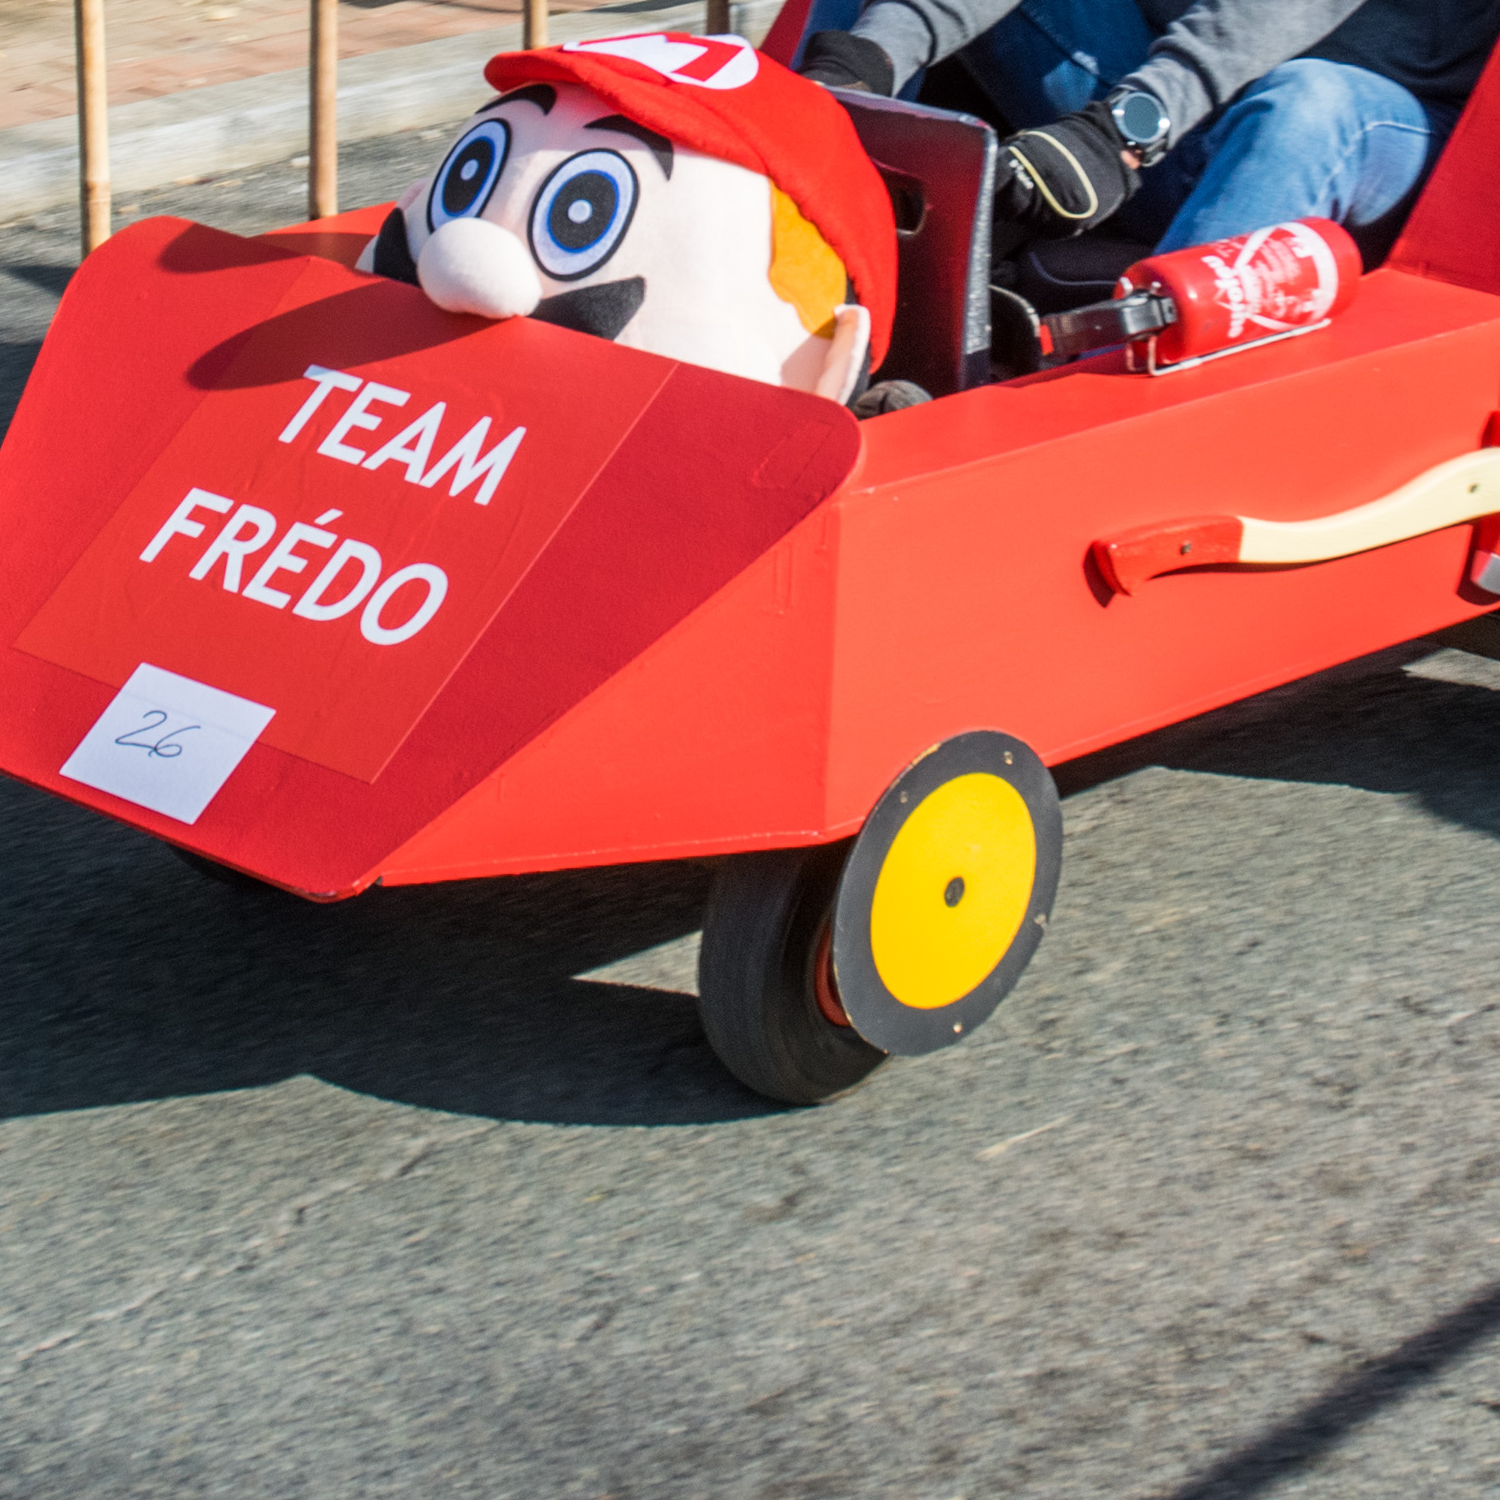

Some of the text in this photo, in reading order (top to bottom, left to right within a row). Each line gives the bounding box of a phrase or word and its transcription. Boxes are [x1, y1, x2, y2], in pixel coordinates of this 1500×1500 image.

[278, 363, 527, 507] TEAM
[138, 487, 449, 646] FRÉDO
[114, 709, 201, 758] 26
